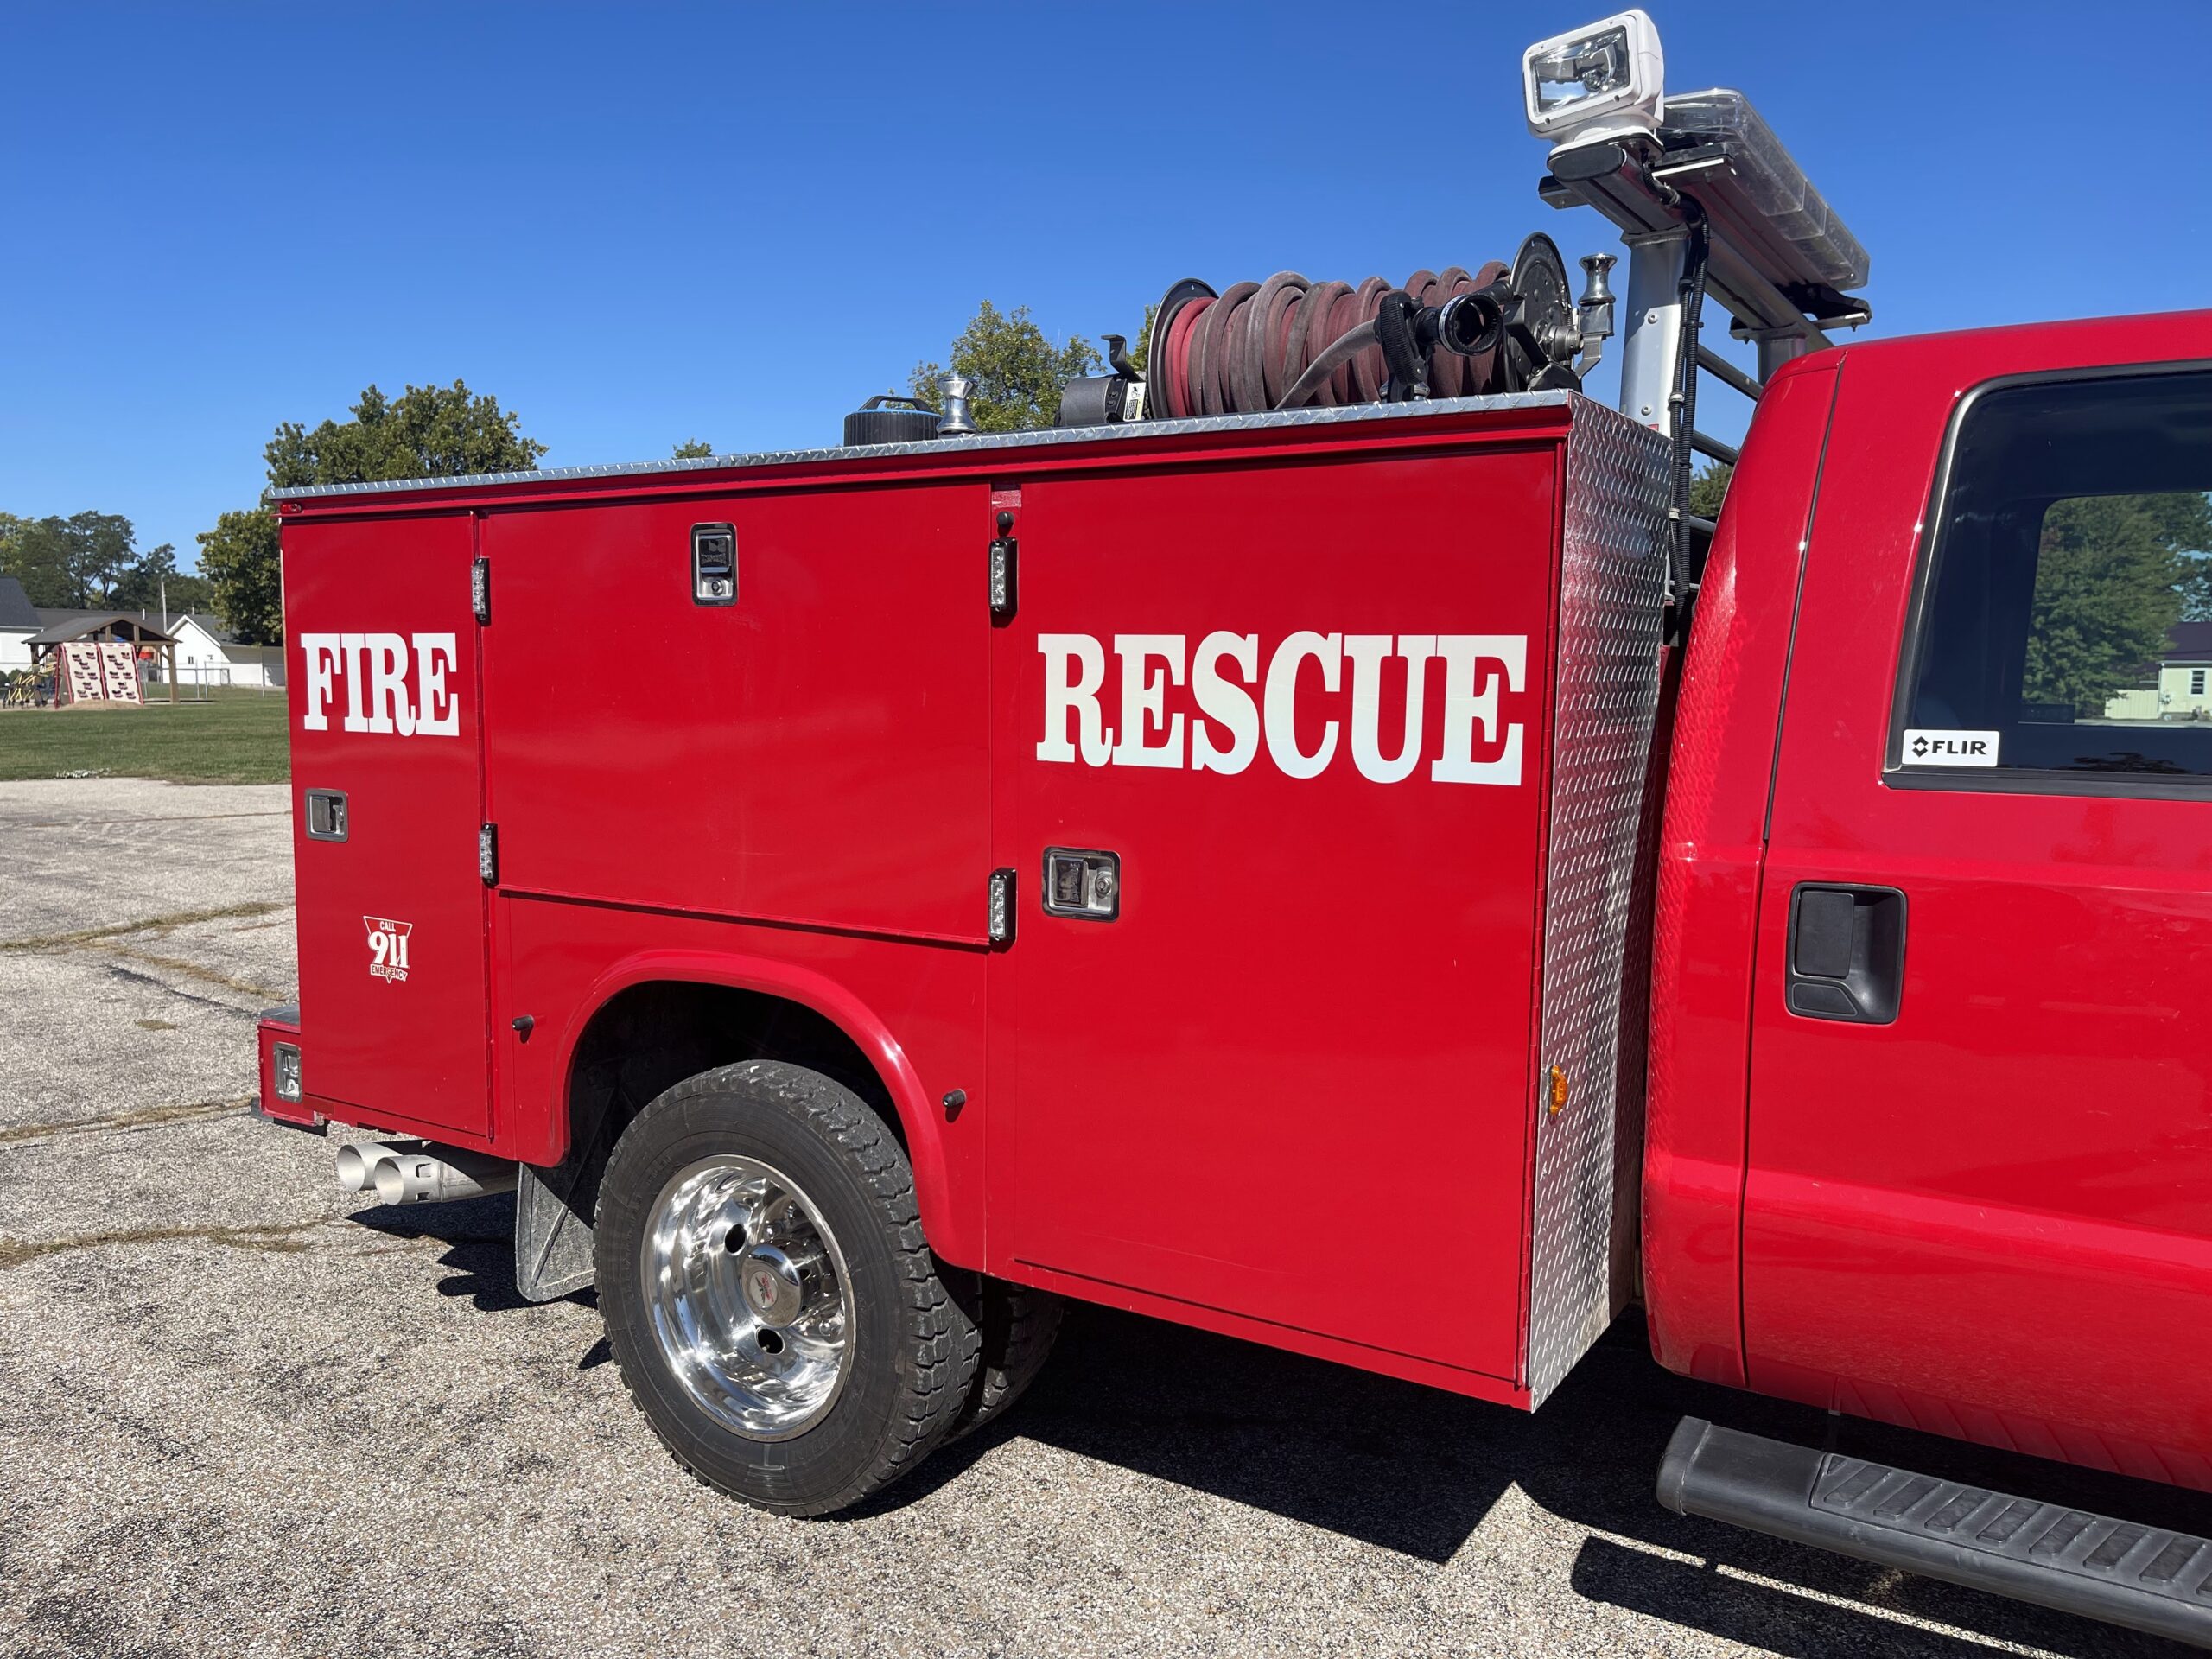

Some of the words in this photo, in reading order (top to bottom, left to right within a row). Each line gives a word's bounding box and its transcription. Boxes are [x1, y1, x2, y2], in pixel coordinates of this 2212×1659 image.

[300, 632, 460, 737] FIRE
[1036, 630, 1528, 786] RESCUE
[1932, 740, 1986, 755] FLIR
[379, 921, 396, 931] CALL
[368, 931, 410, 969] 911
[372, 965, 407, 981] EMERGENCY
